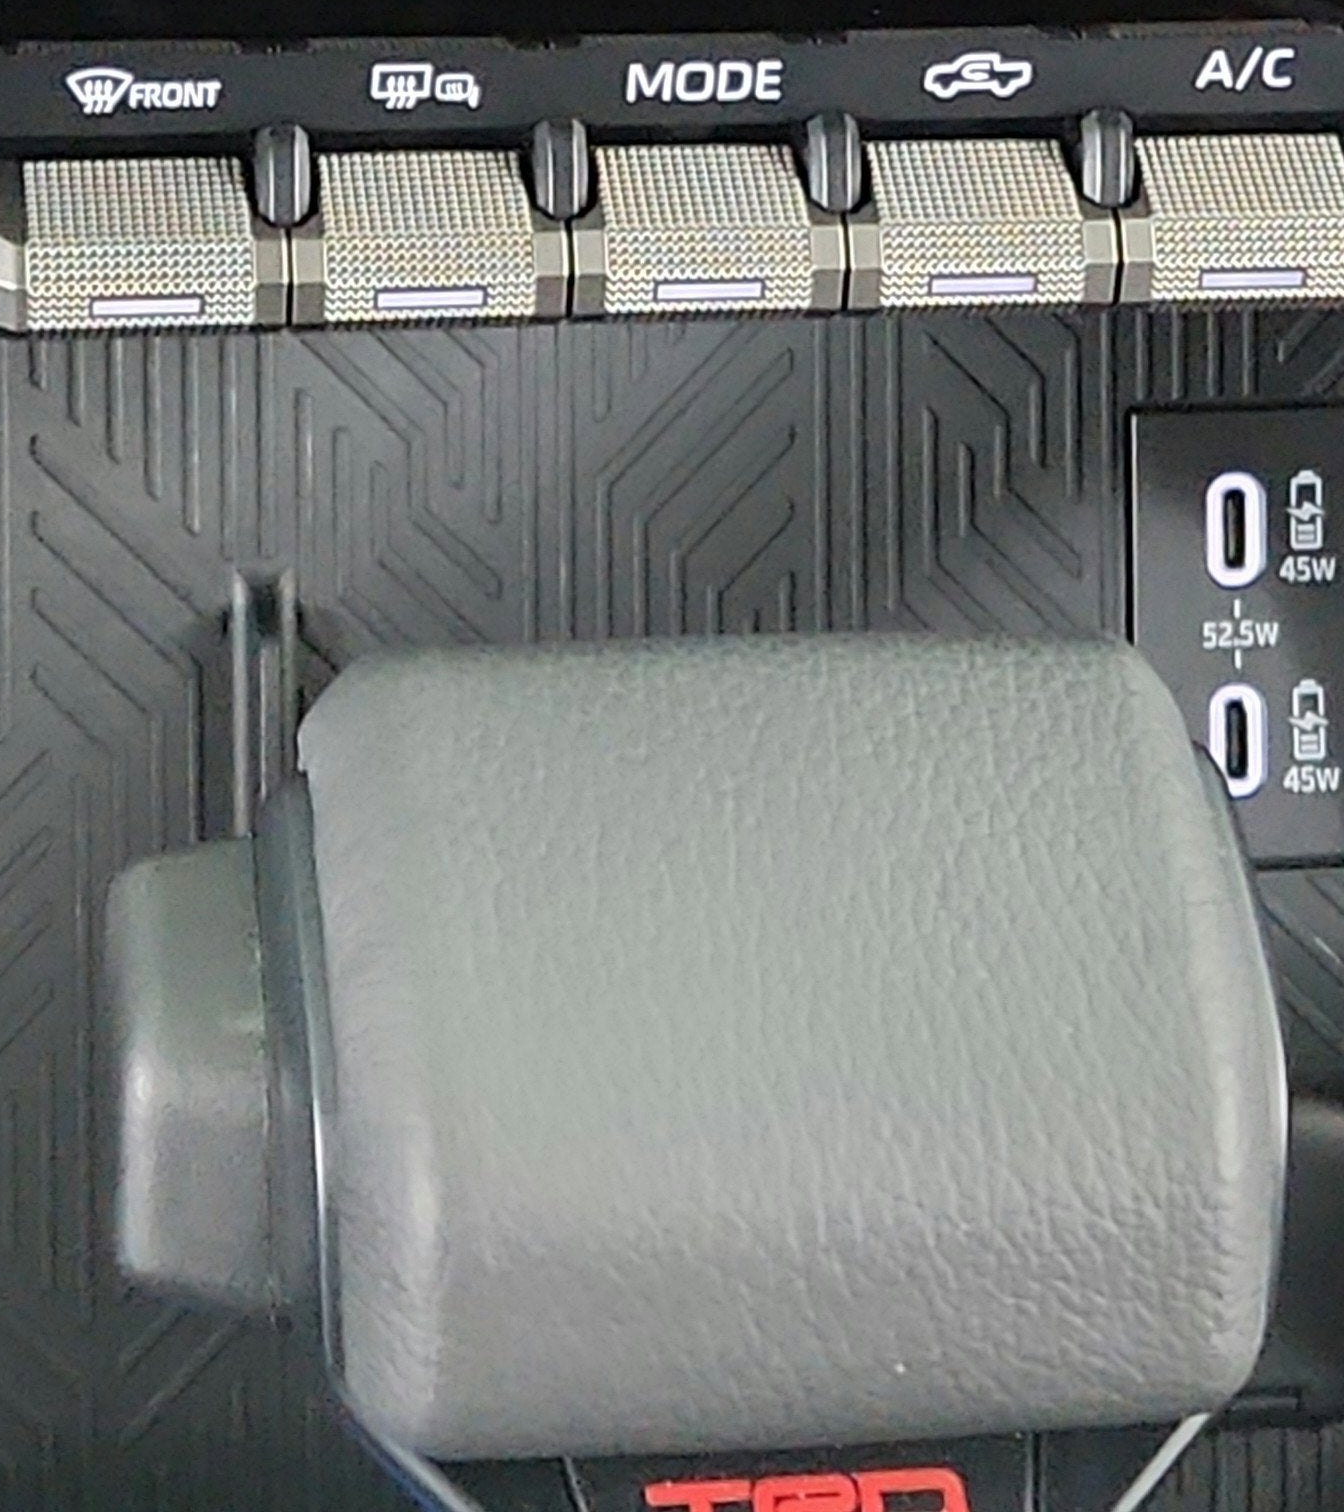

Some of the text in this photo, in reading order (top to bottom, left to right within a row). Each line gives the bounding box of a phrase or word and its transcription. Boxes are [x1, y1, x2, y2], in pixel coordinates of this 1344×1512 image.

[625, 59, 784, 104] MODE
[1194, 45, 1297, 92] A/C
[127, 78, 223, 111] FRONT
[1278, 555, 1337, 584] 45W
[1201, 619, 1280, 650] 52.5W
[1281, 764, 1342, 794] 45W
